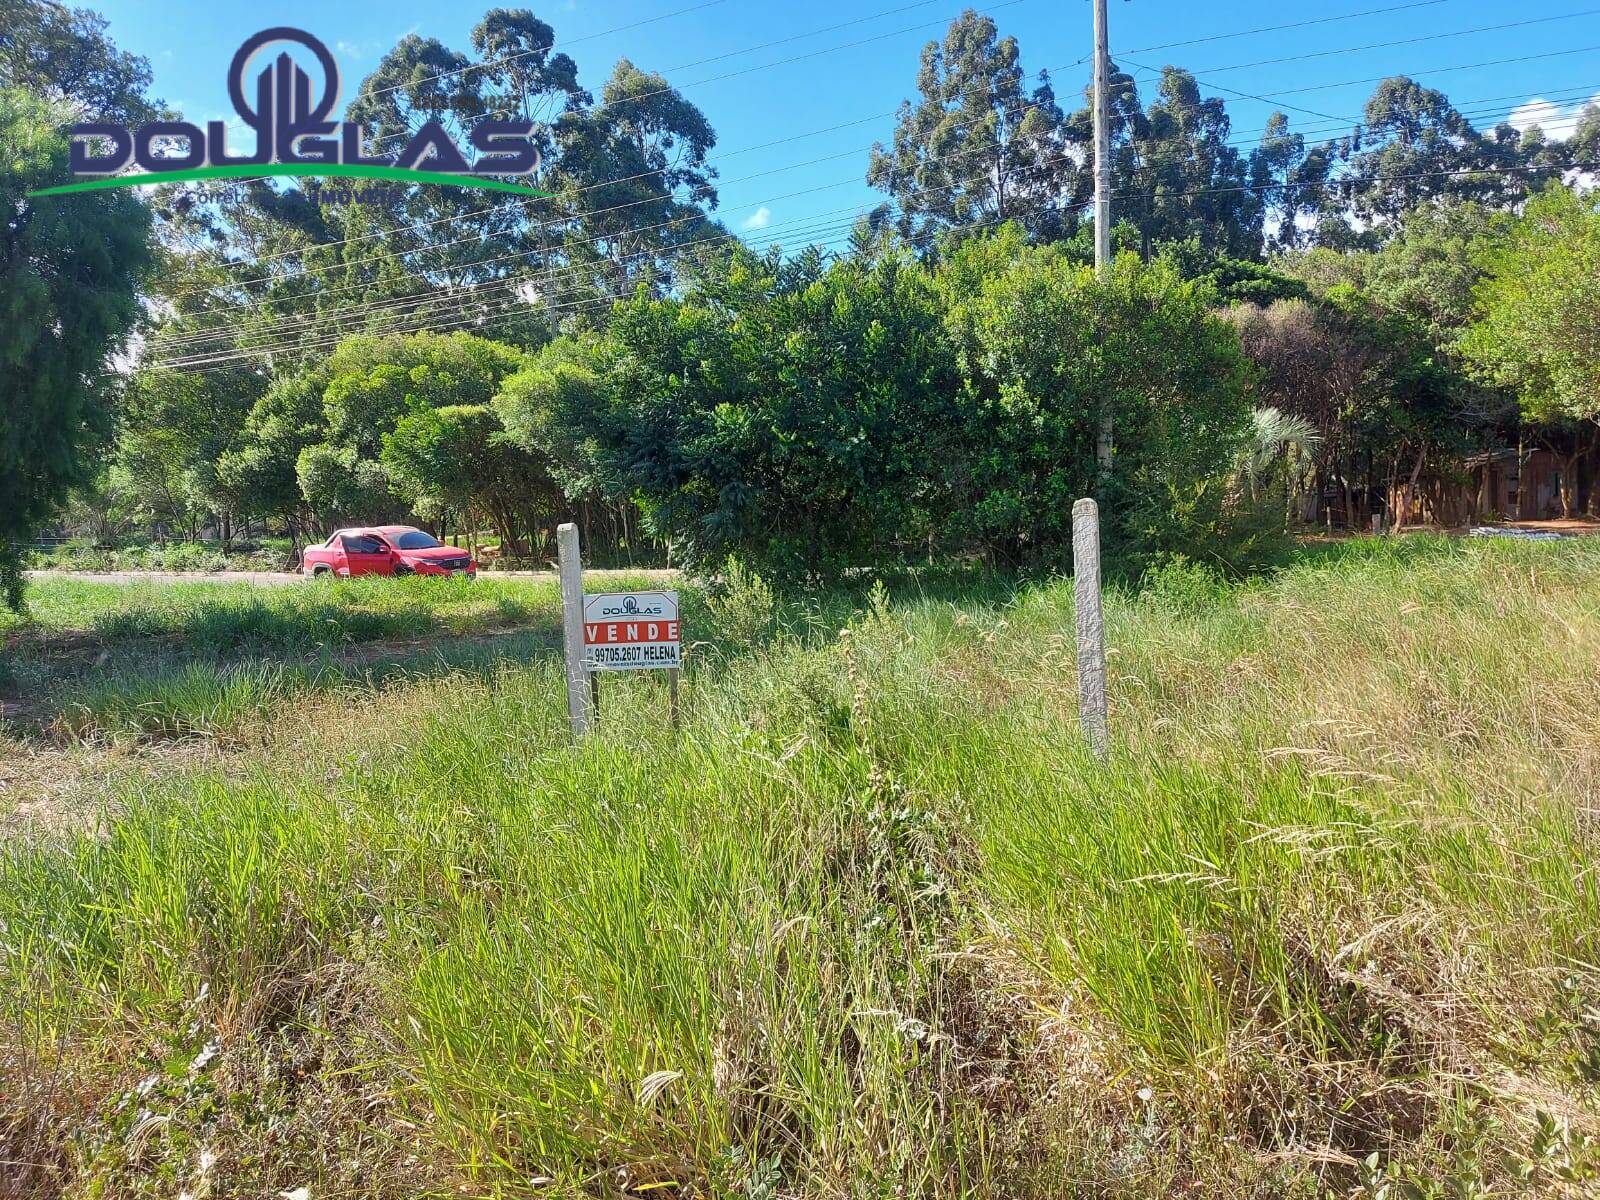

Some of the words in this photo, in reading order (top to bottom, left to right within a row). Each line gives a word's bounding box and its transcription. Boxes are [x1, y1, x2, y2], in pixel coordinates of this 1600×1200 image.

[602, 607, 662, 615] DOUGLAS
[586, 623, 678, 642] VENDE
[595, 646, 641, 664] 99705.2607
[643, 645, 676, 661] HELENA
